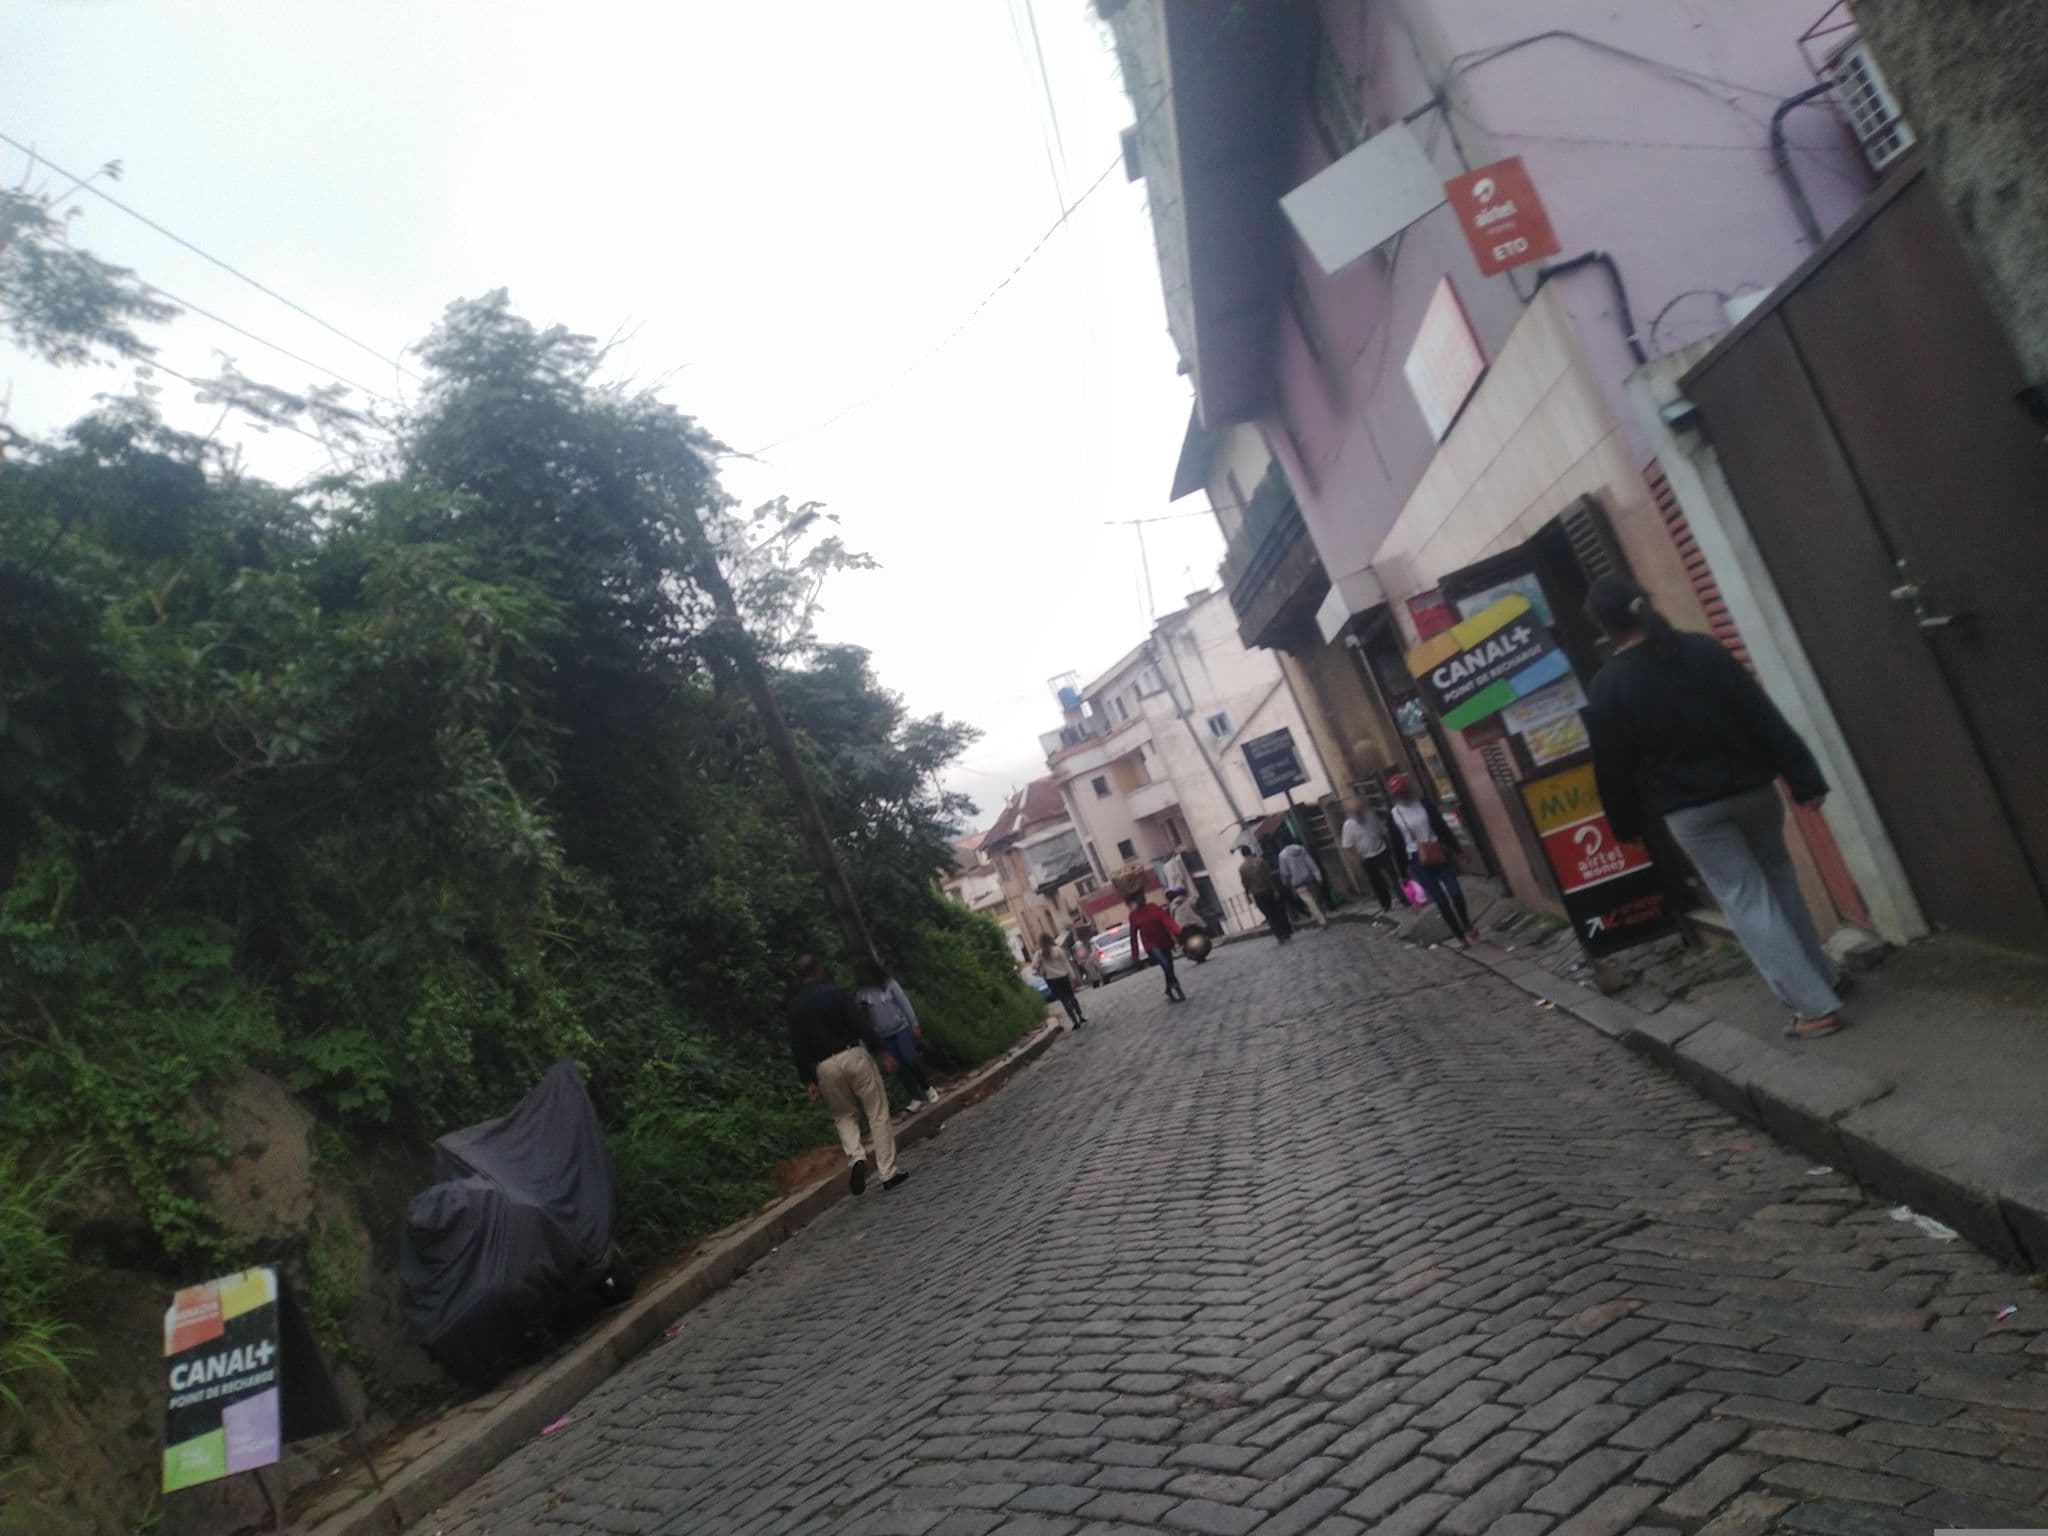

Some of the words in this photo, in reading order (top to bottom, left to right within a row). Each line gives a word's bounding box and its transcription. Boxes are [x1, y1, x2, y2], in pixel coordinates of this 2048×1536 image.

[1432, 624, 1532, 689] CANAL+
[1444, 682, 1475, 703] POINT
[1476, 673, 1491, 688] DE
[1577, 846, 1625, 872] airtel
[169, 1339, 275, 1391] CANAL+
[169, 1391, 205, 1410] POINT
[205, 1386, 221, 1400] DE
